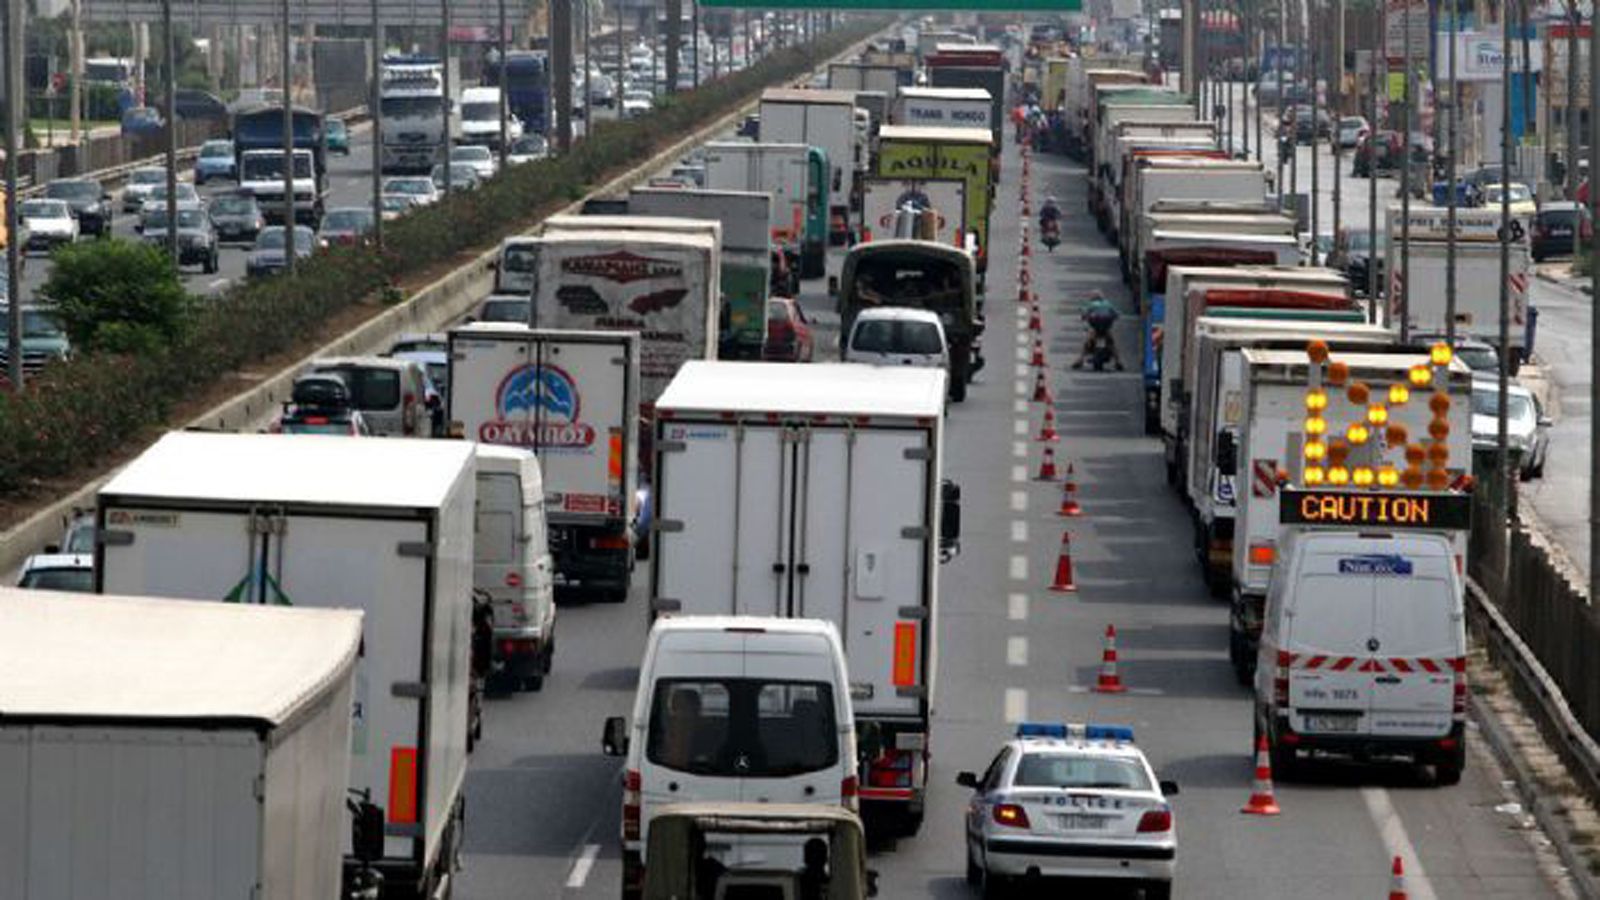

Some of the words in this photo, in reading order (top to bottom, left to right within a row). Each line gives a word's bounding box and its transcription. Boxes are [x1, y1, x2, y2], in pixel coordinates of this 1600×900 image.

[890, 157, 978, 175] AQUILA
[1301, 495, 1428, 522] CAUTION
[1043, 796, 1123, 810] POLICE
